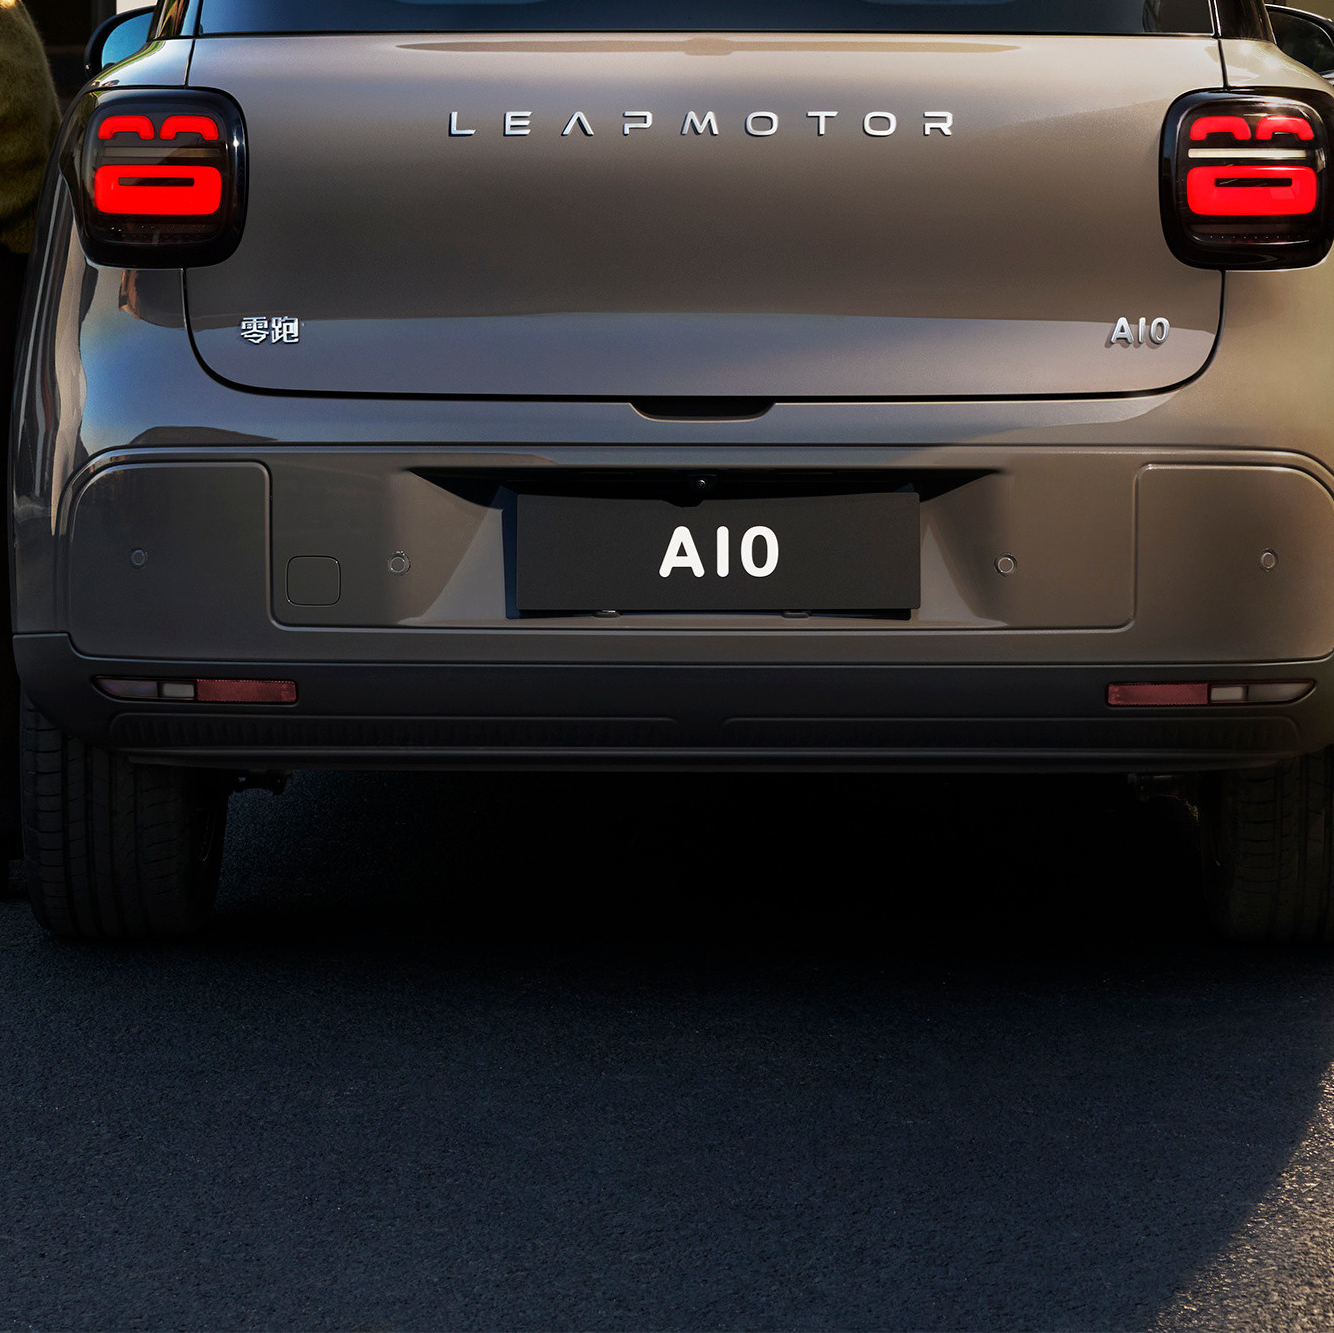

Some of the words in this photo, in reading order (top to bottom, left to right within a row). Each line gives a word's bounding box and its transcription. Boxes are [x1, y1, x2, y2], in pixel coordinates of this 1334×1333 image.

[449, 110, 954, 137] LEAPMOTOR
[240, 316, 299, 344] 零跑
[1110, 316, 1170, 345] A10
[658, 525, 779, 578] A10
